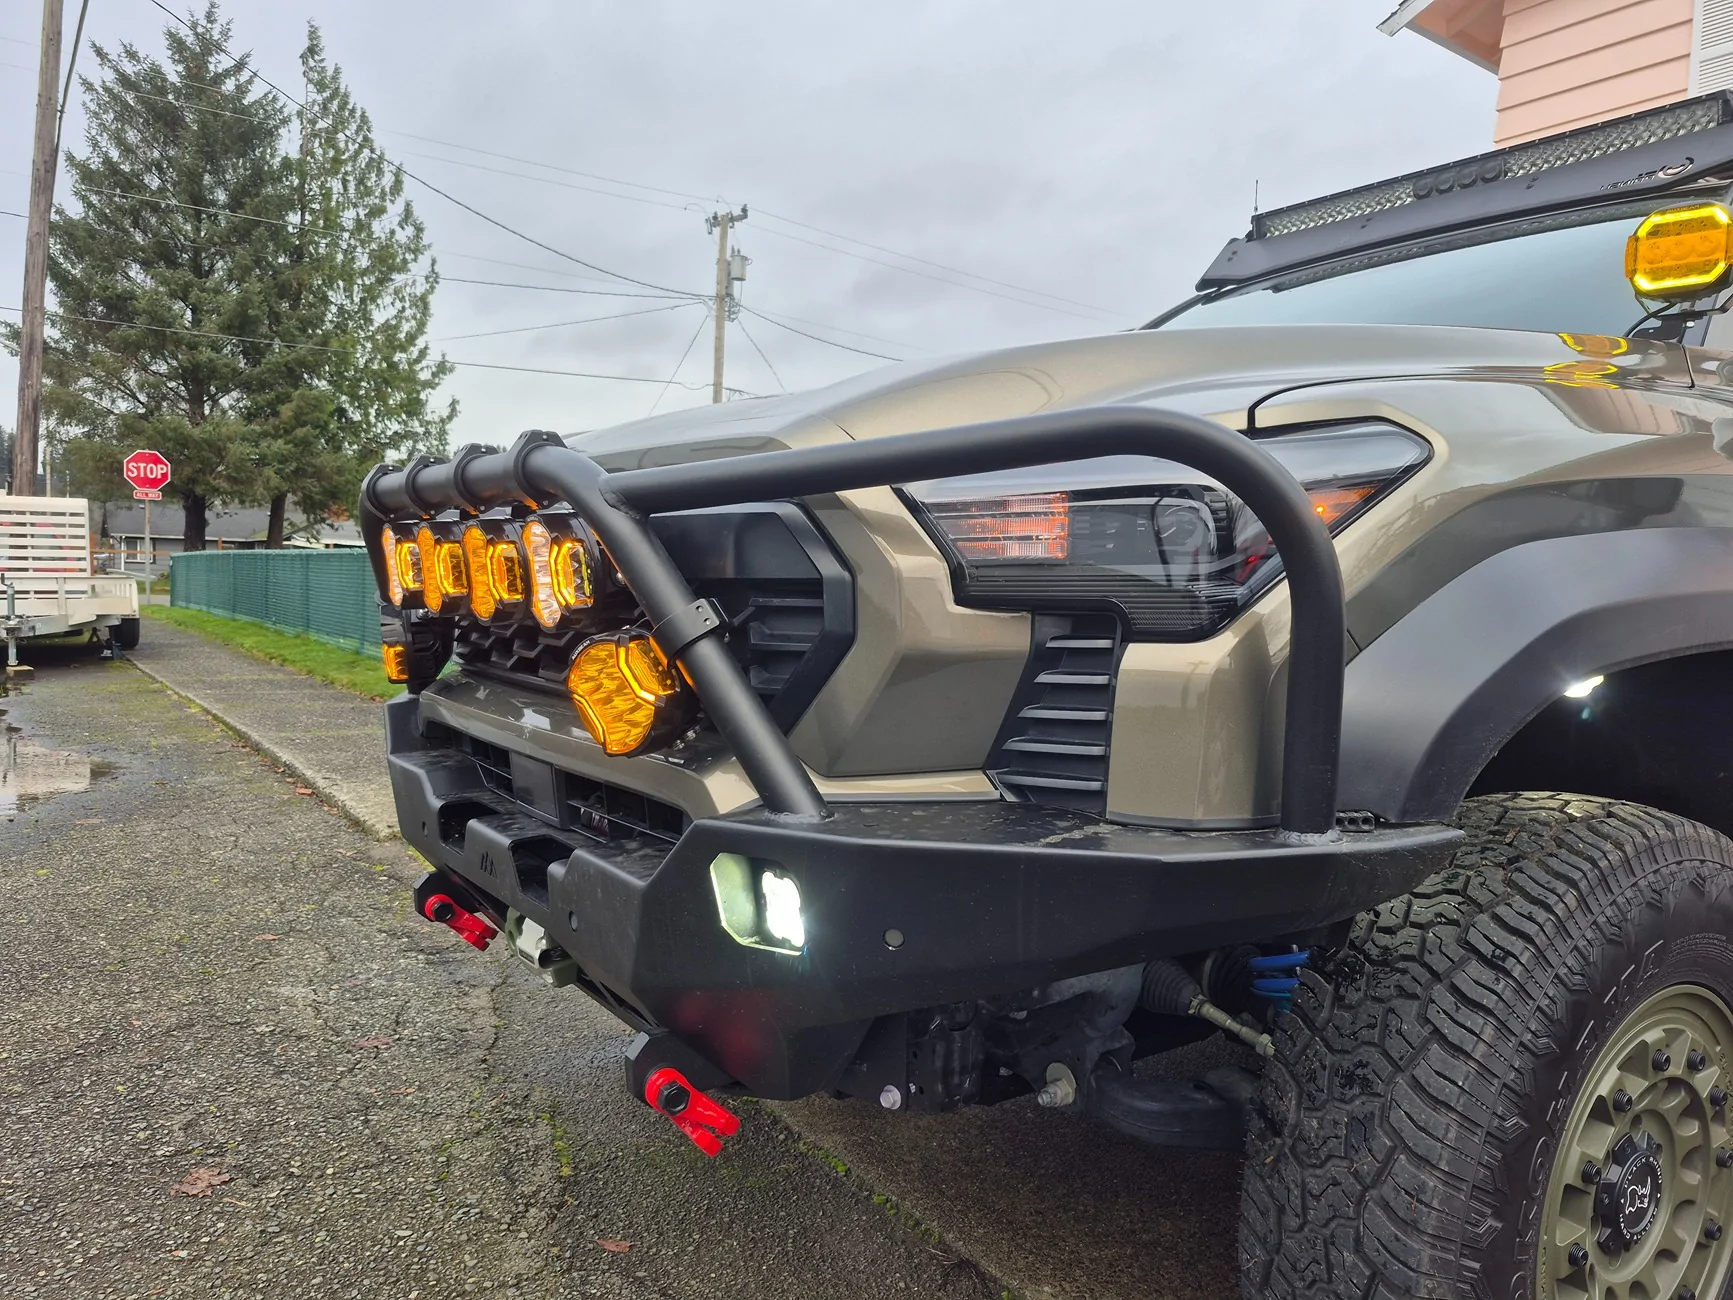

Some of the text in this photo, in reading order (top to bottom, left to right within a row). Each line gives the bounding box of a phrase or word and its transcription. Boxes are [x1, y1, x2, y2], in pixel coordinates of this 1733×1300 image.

[128, 462, 167, 479] STOP
[571, 640, 591, 660] AUXBEAM
[1624, 1156, 1663, 1188] BLACK RHINO
[1619, 1207, 1658, 1241] HARD ALLOYS
